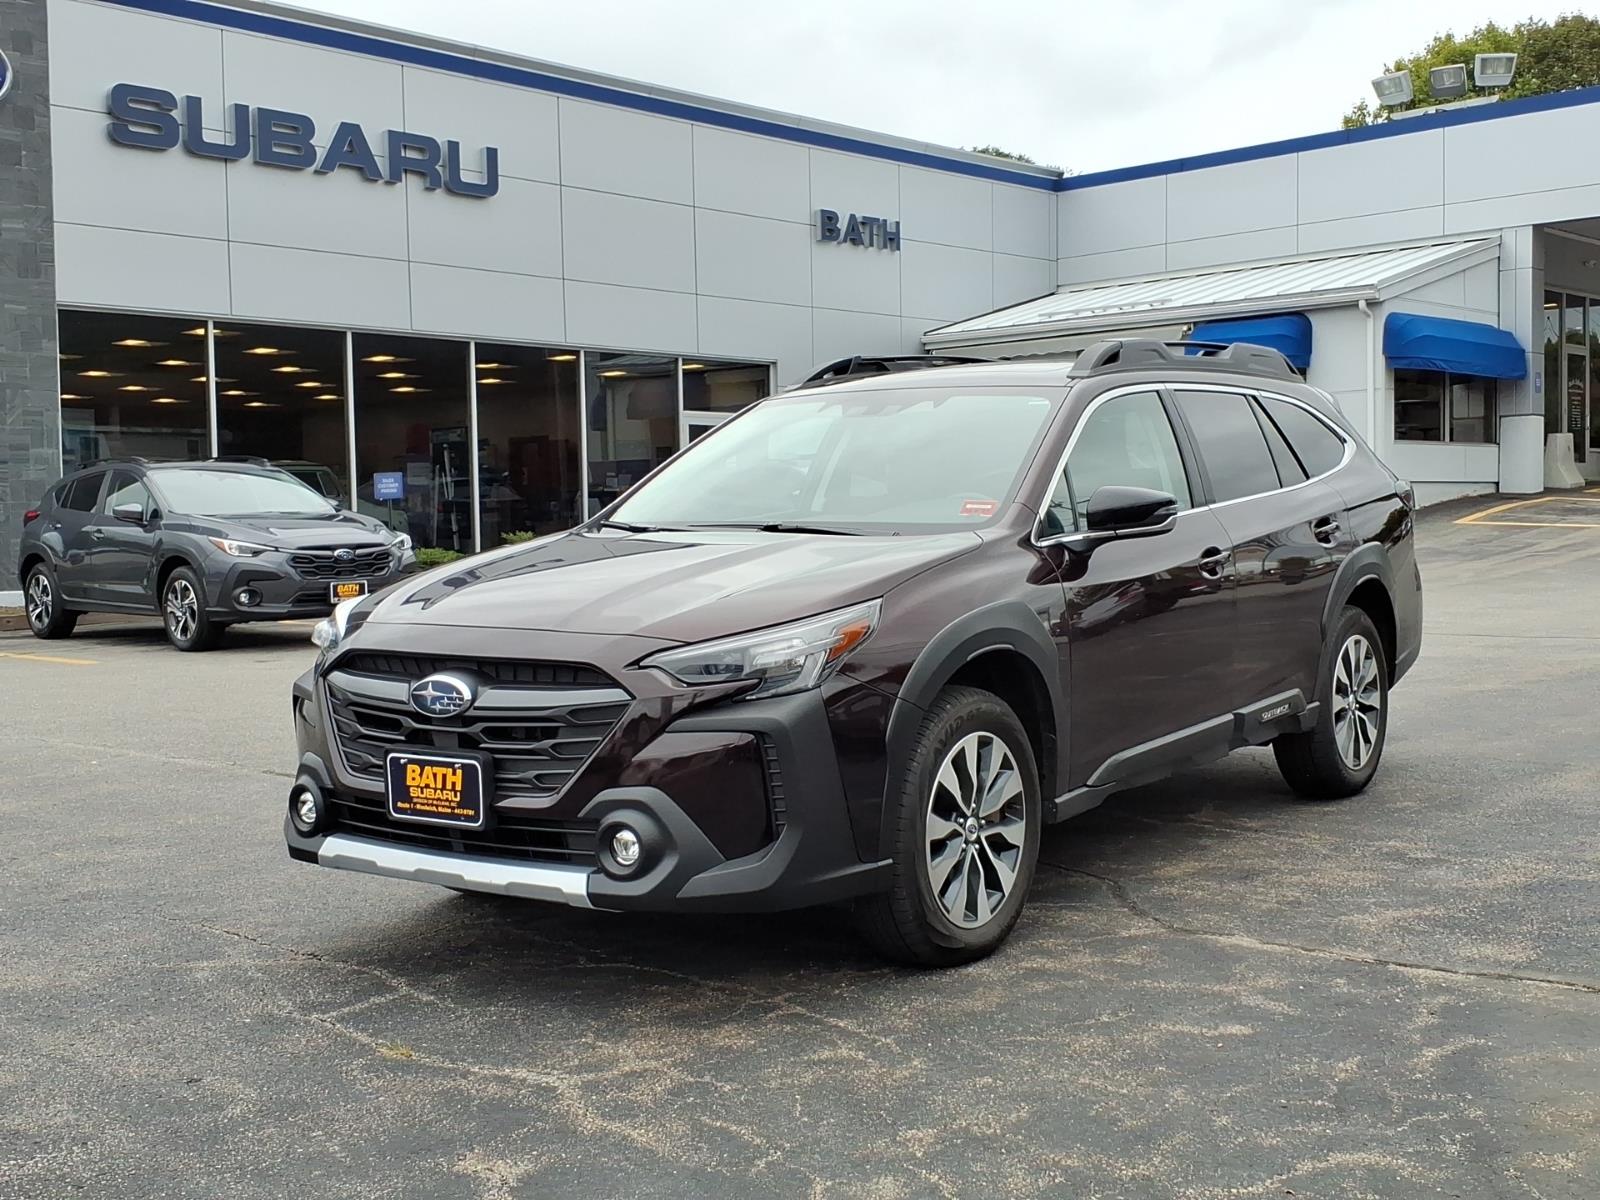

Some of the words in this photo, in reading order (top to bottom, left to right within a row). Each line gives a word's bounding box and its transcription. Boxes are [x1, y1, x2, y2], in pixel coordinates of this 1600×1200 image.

[107, 83, 499, 199] SUBARU
[815, 208, 901, 251] BATH
[337, 583, 360, 594] BATH
[407, 765, 462, 790] BATH
[410, 788, 460, 801] SUBARU
